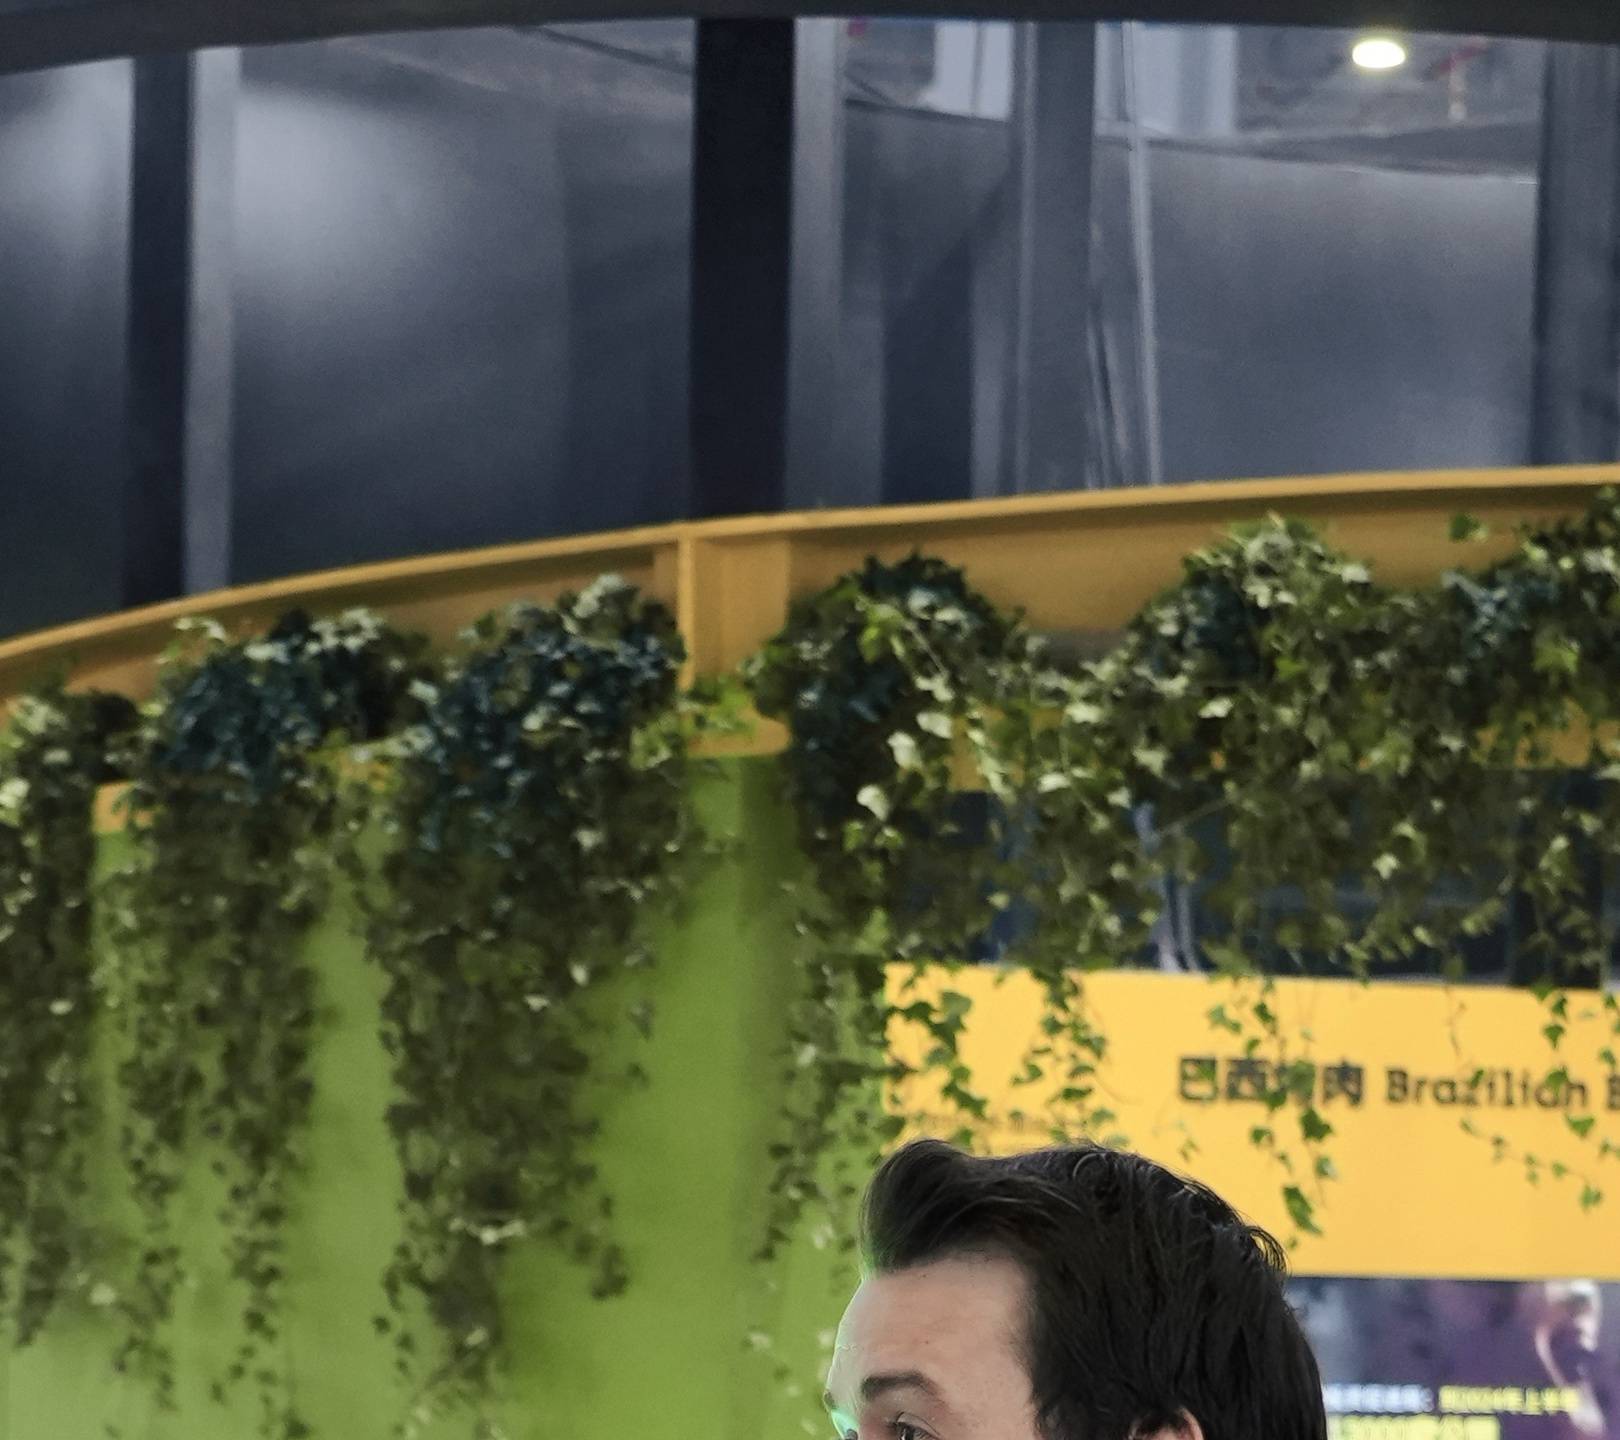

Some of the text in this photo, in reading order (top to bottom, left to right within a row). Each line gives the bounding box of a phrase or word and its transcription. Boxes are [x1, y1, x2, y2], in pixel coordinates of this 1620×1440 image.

[1177, 1056, 1366, 1108] 巴西肉
[1383, 1066, 1589, 1109] Brazilian
